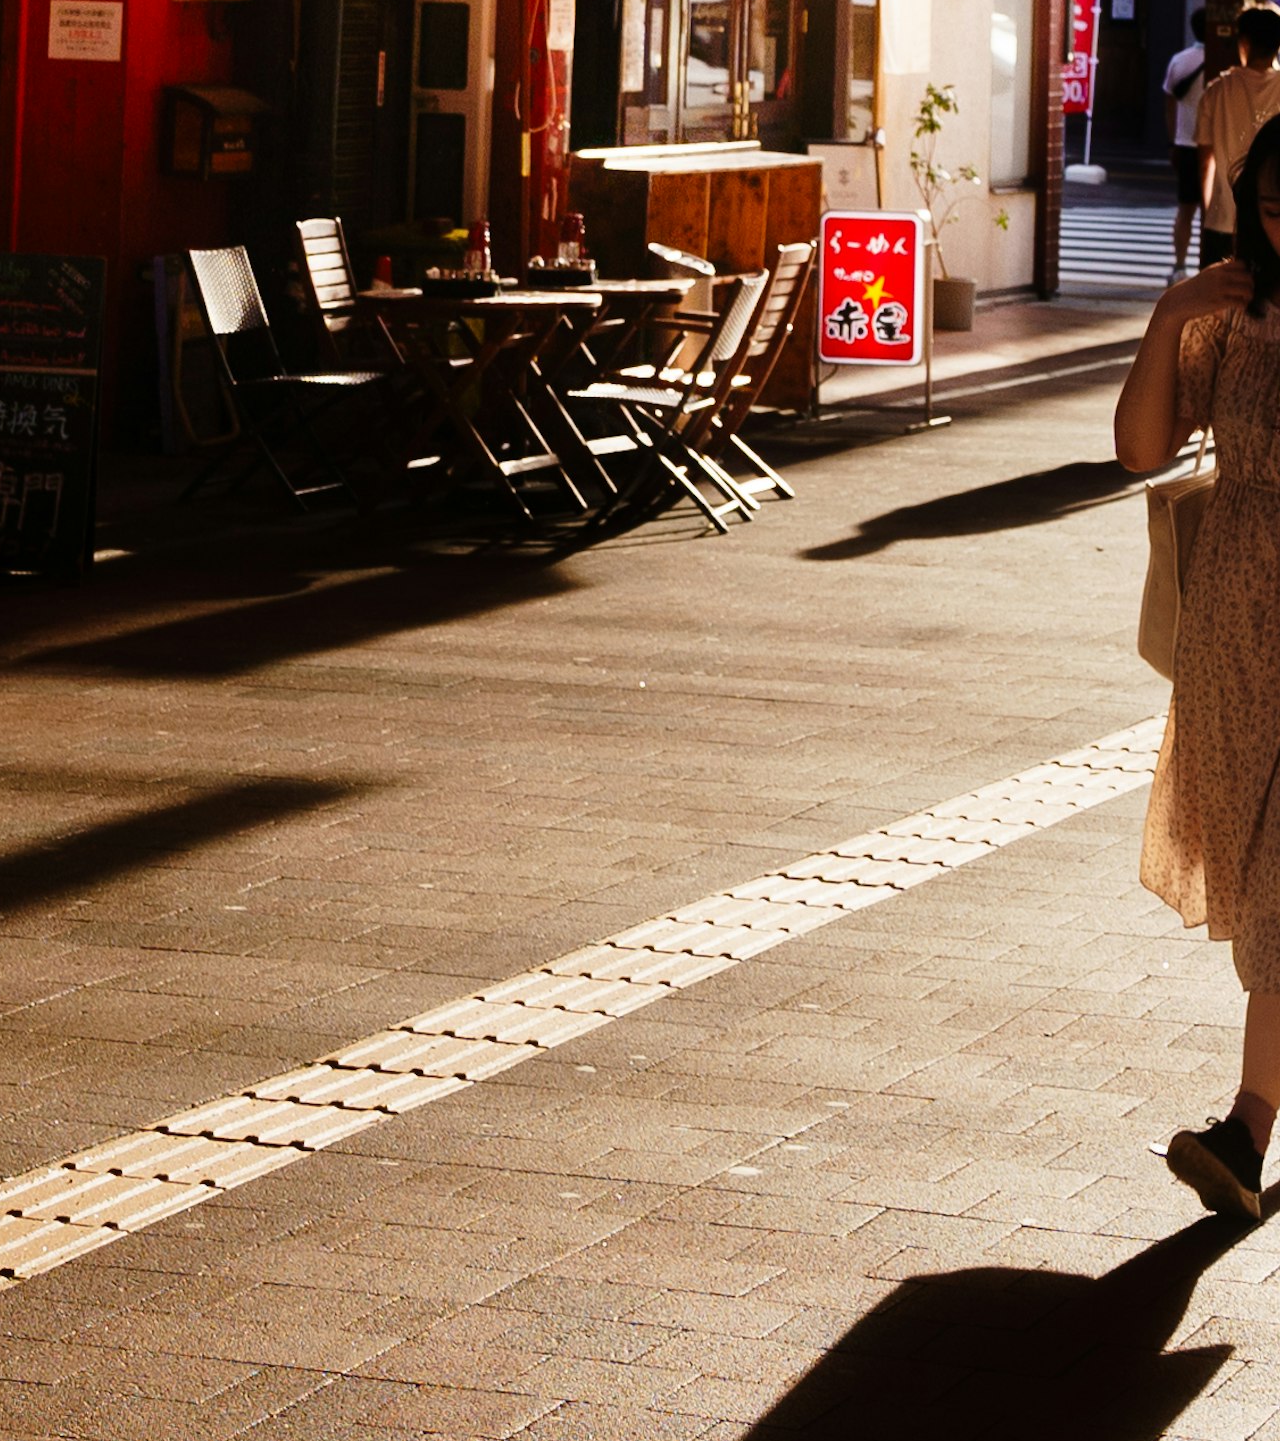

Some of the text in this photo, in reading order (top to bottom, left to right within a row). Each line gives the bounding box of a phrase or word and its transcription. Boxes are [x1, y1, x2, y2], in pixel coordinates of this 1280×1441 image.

[829, 230, 908, 255] らーめん
[825, 298, 910, 345] 赤星
